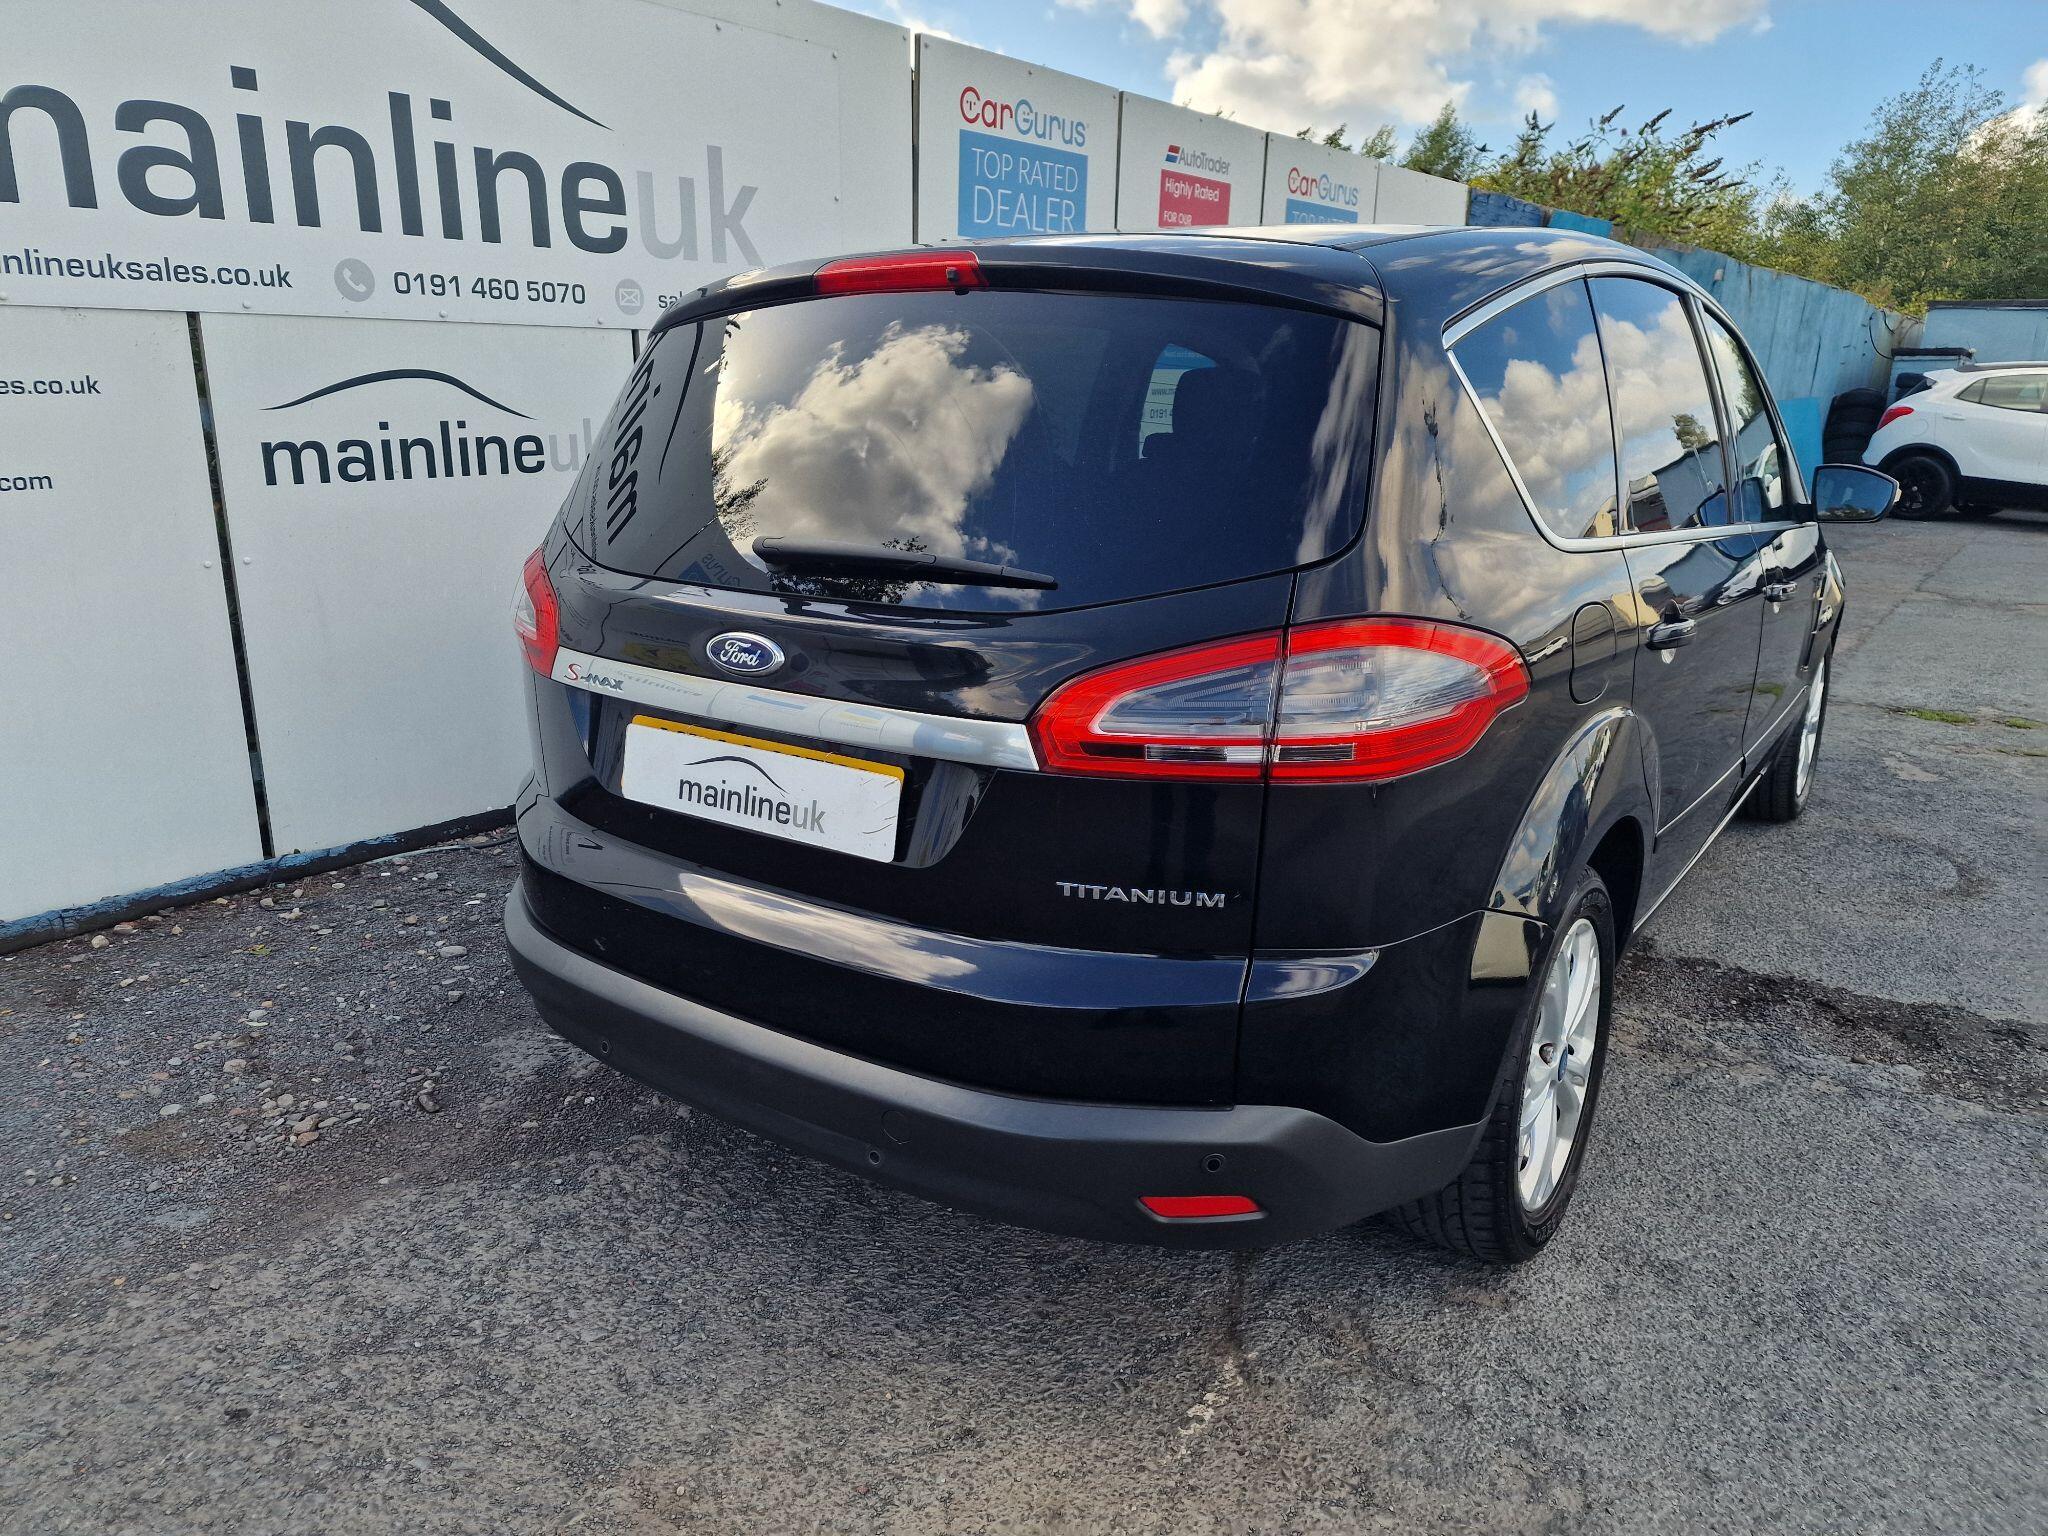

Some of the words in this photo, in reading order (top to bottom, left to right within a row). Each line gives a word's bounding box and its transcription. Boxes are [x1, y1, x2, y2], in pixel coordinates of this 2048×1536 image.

[960, 86, 1086, 147] CarGurus
[971, 148, 1013, 180] TOP
[1019, 157, 1078, 192] RATED
[1178, 147, 1231, 176] AutoTrader
[1165, 178, 1193, 198] Highly
[1194, 182, 1220, 202] Rated
[1288, 167, 1359, 206] CarGurus
[974, 185, 1076, 232] DEALER
[1163, 210, 1177, 223] FOR
[0, 249, 293, 288] nlineuksales.co.uk
[393, 271, 461, 297] 0191
[471, 277, 520, 301] 460
[527, 280, 586, 304] 5070
[720, 640, 761, 666] Ford
[564, 663, 625, 692] S-MAX
[678, 778, 826, 834] mainlineuk
[1056, 881, 1226, 908] TITANIUM
